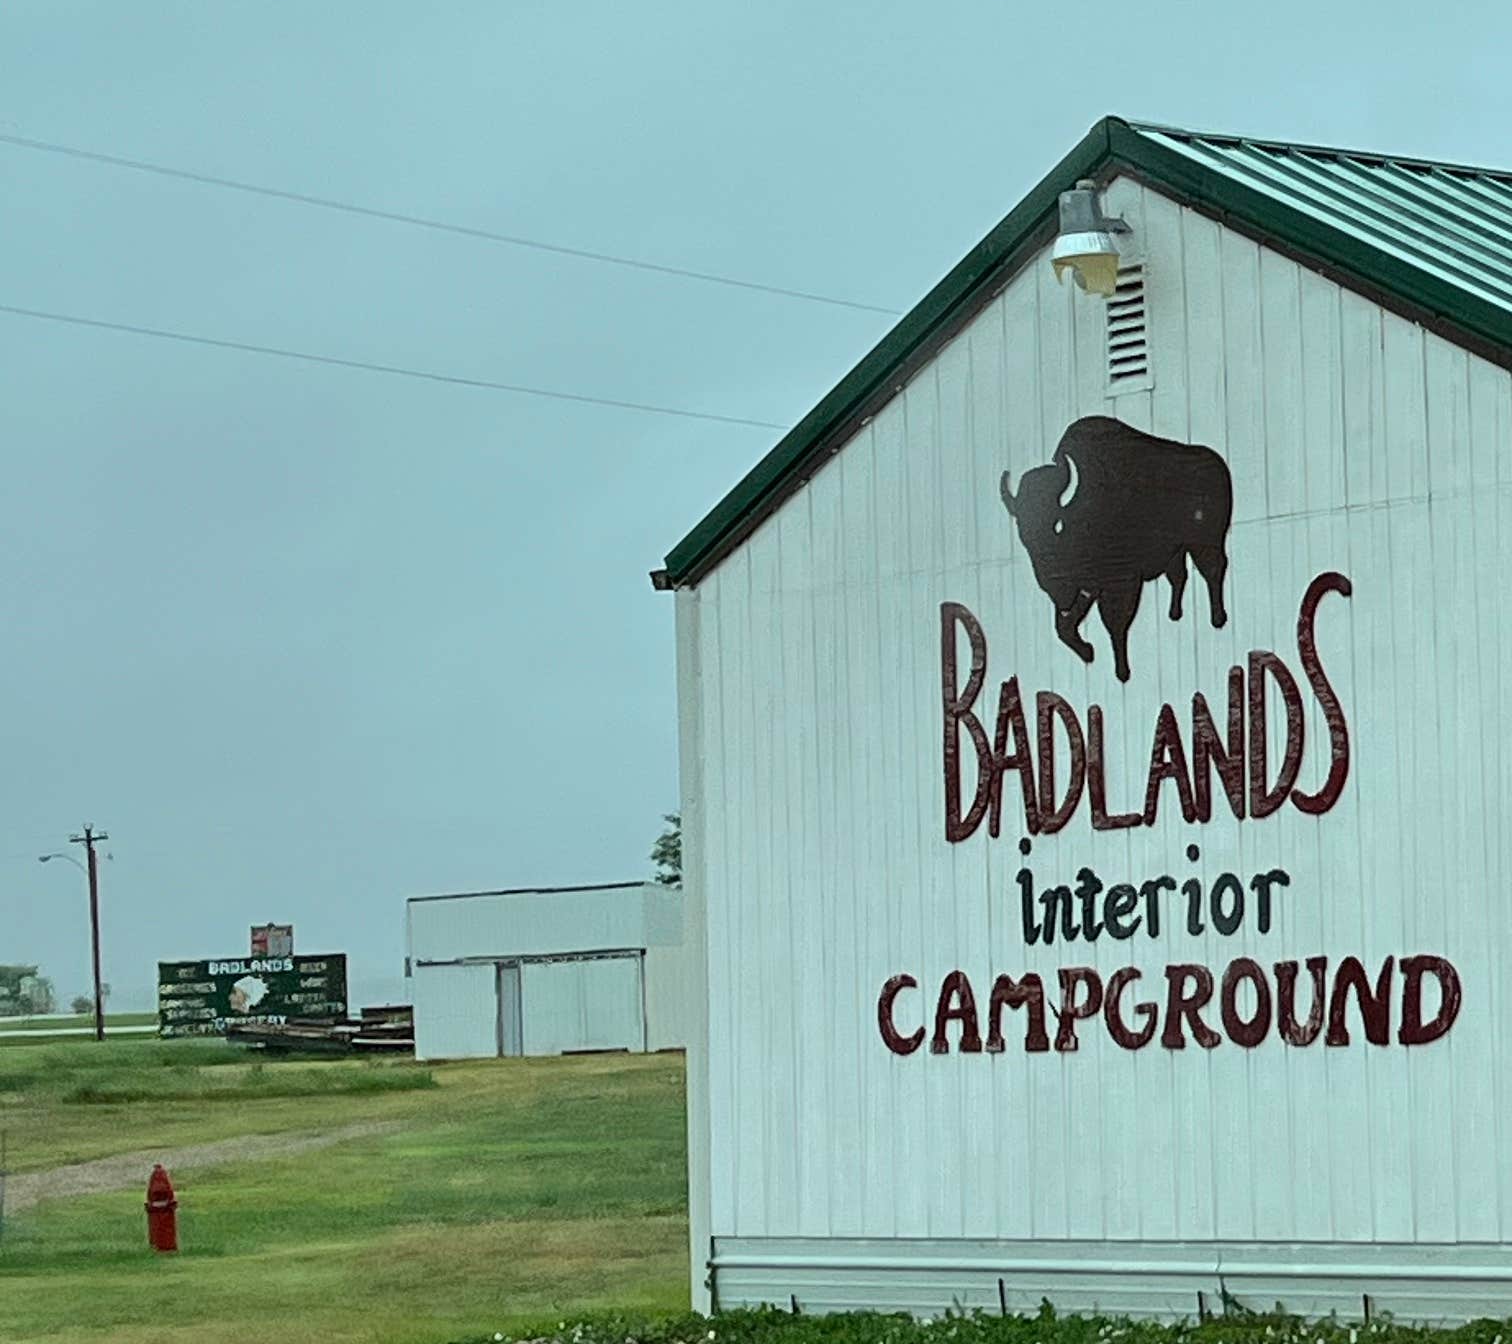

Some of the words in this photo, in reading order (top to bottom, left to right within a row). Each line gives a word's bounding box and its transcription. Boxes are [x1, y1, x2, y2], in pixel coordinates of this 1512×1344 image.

[941, 571, 1353, 843] BADLANDS
[1016, 838, 1289, 945] interior
[208, 958, 293, 975] BADLANDS
[877, 954, 1461, 1055] CAMPGROUND
